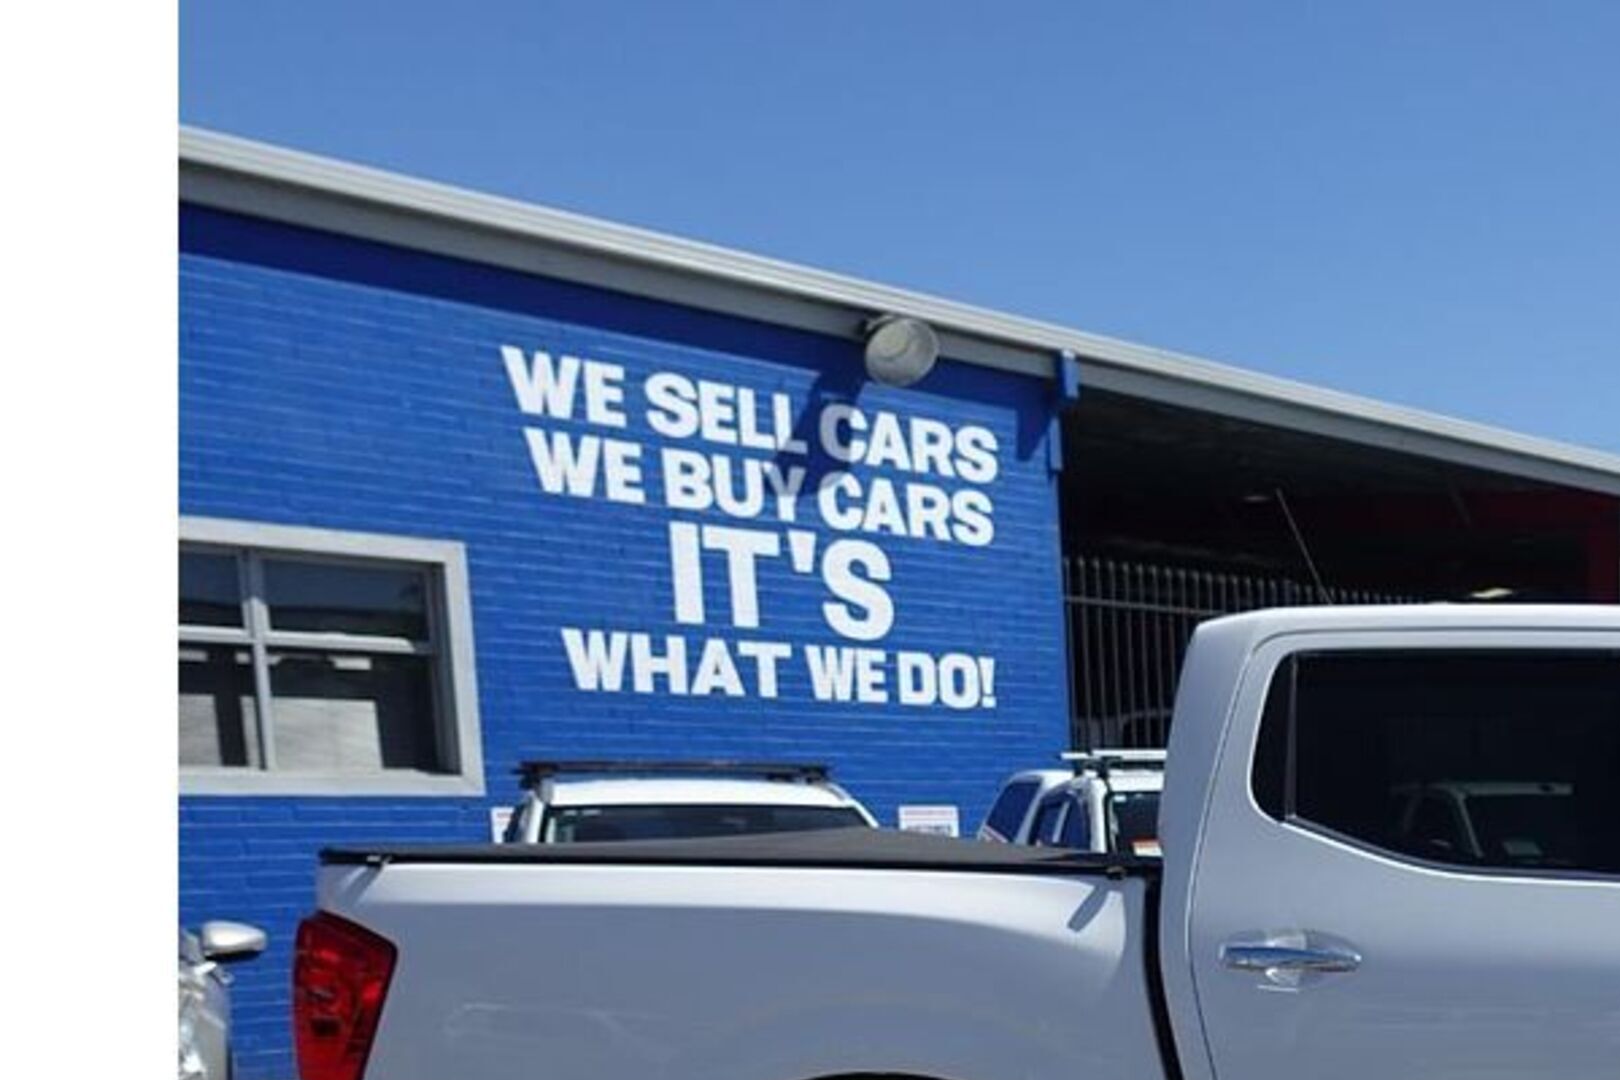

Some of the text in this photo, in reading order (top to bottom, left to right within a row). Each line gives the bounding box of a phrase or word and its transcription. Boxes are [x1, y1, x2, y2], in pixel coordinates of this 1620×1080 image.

[500, 344, 999, 484] WE SELL CARS
[523, 426, 996, 547] WE BUY CARS
[668, 521, 895, 642] IT'S
[560, 628, 997, 709] WHAT WE DO!
